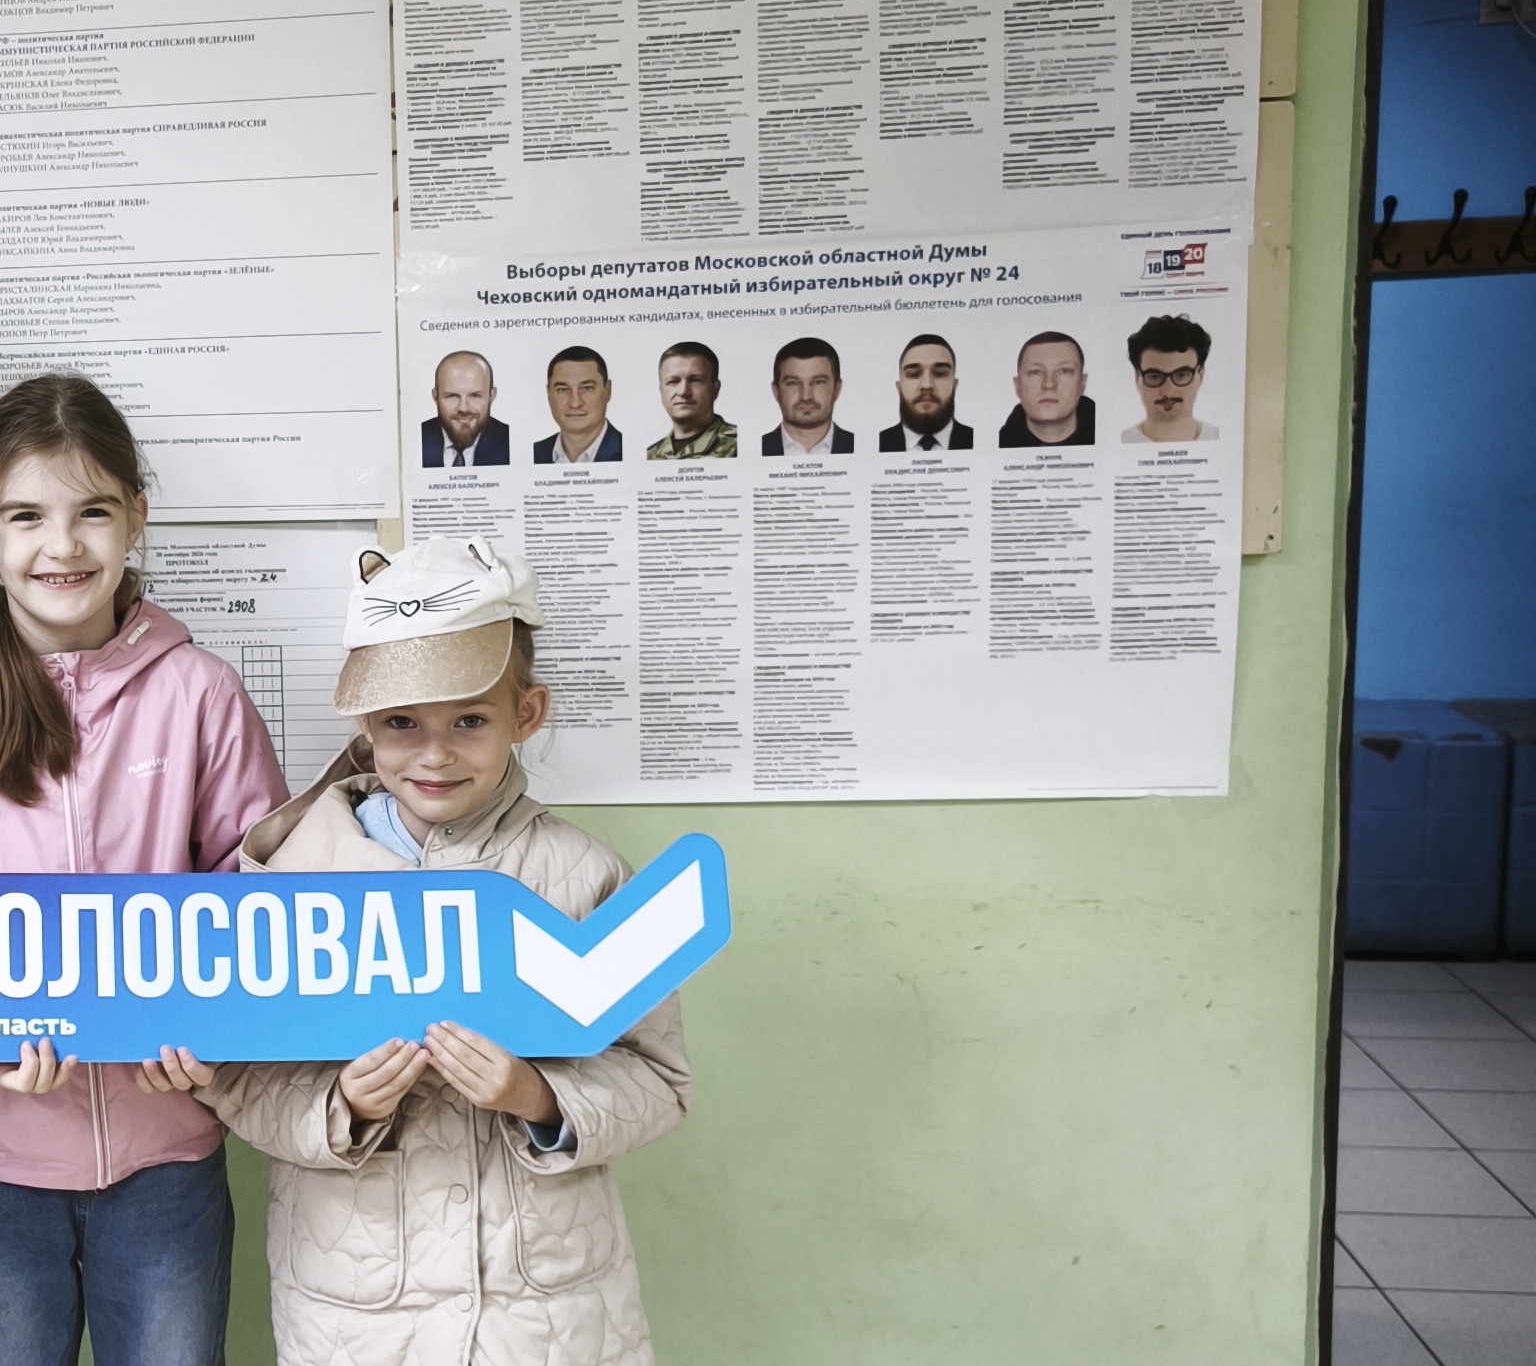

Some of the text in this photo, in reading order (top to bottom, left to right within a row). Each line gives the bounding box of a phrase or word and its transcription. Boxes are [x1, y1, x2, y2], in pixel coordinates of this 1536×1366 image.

[506, 243, 986, 280] Выборы депутатов Московской областной Думы
[1184, 248, 1202, 260] 20
[476, 265, 1019, 304] Чеховский одномандатный избирательный округ № 24
[419, 293, 1082, 331] Сведения о зарегистрированных кандидатах, внесенных в избирательный бюллетень для голосования
[228, 598, 256, 613] 2908
